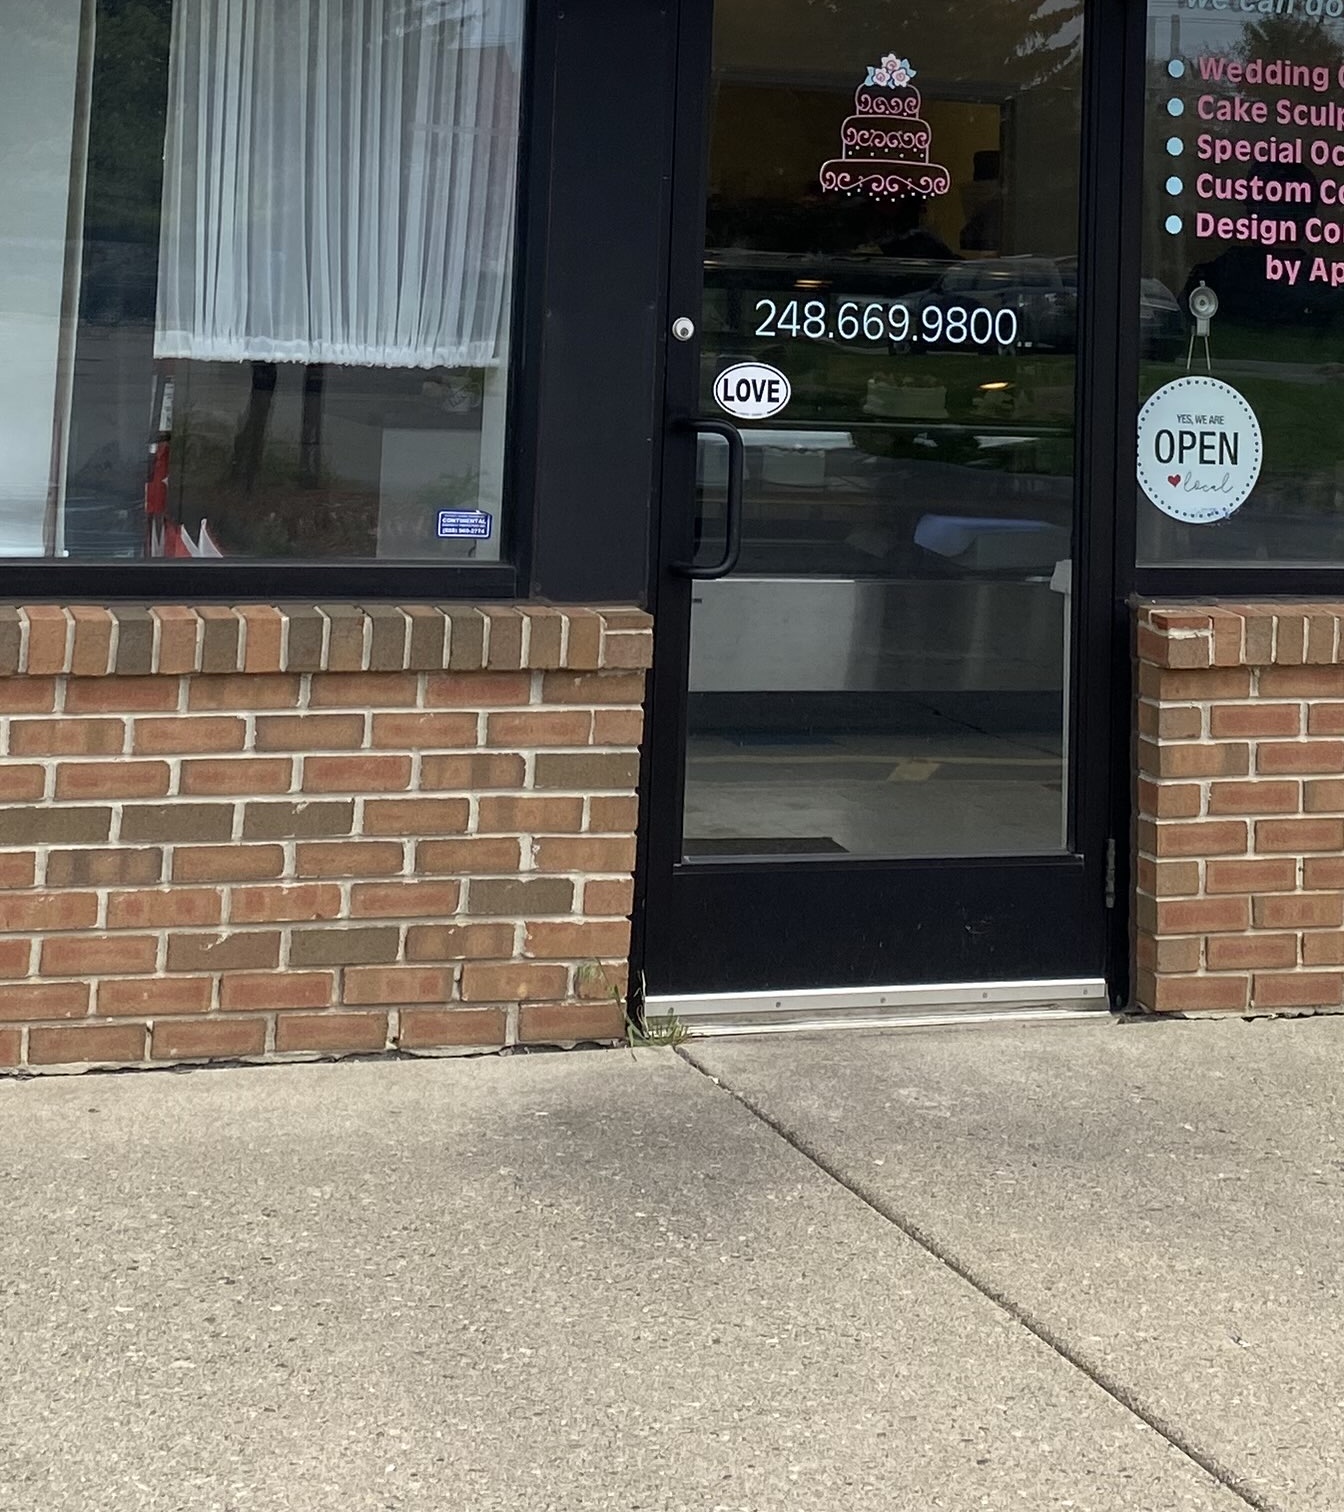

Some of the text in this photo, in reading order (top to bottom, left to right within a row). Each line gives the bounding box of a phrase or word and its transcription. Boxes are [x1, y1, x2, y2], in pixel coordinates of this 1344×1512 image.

[1198, 57, 1329, 92] Wedding
[1197, 95, 1268, 123] Cake
[1197, 134, 1303, 165] Special
[1196, 173, 1312, 203] Custom
[1195, 212, 1297, 245] Design
[1266, 254, 1301, 286] by
[754, 298, 1018, 346] 248.669.9800
[722, 377, 781, 404] LOVE
[1176, 414, 1225, 426] YES, WE ARE
[1154, 428, 1240, 466] OPEN
[1183, 469, 1234, 494] local
